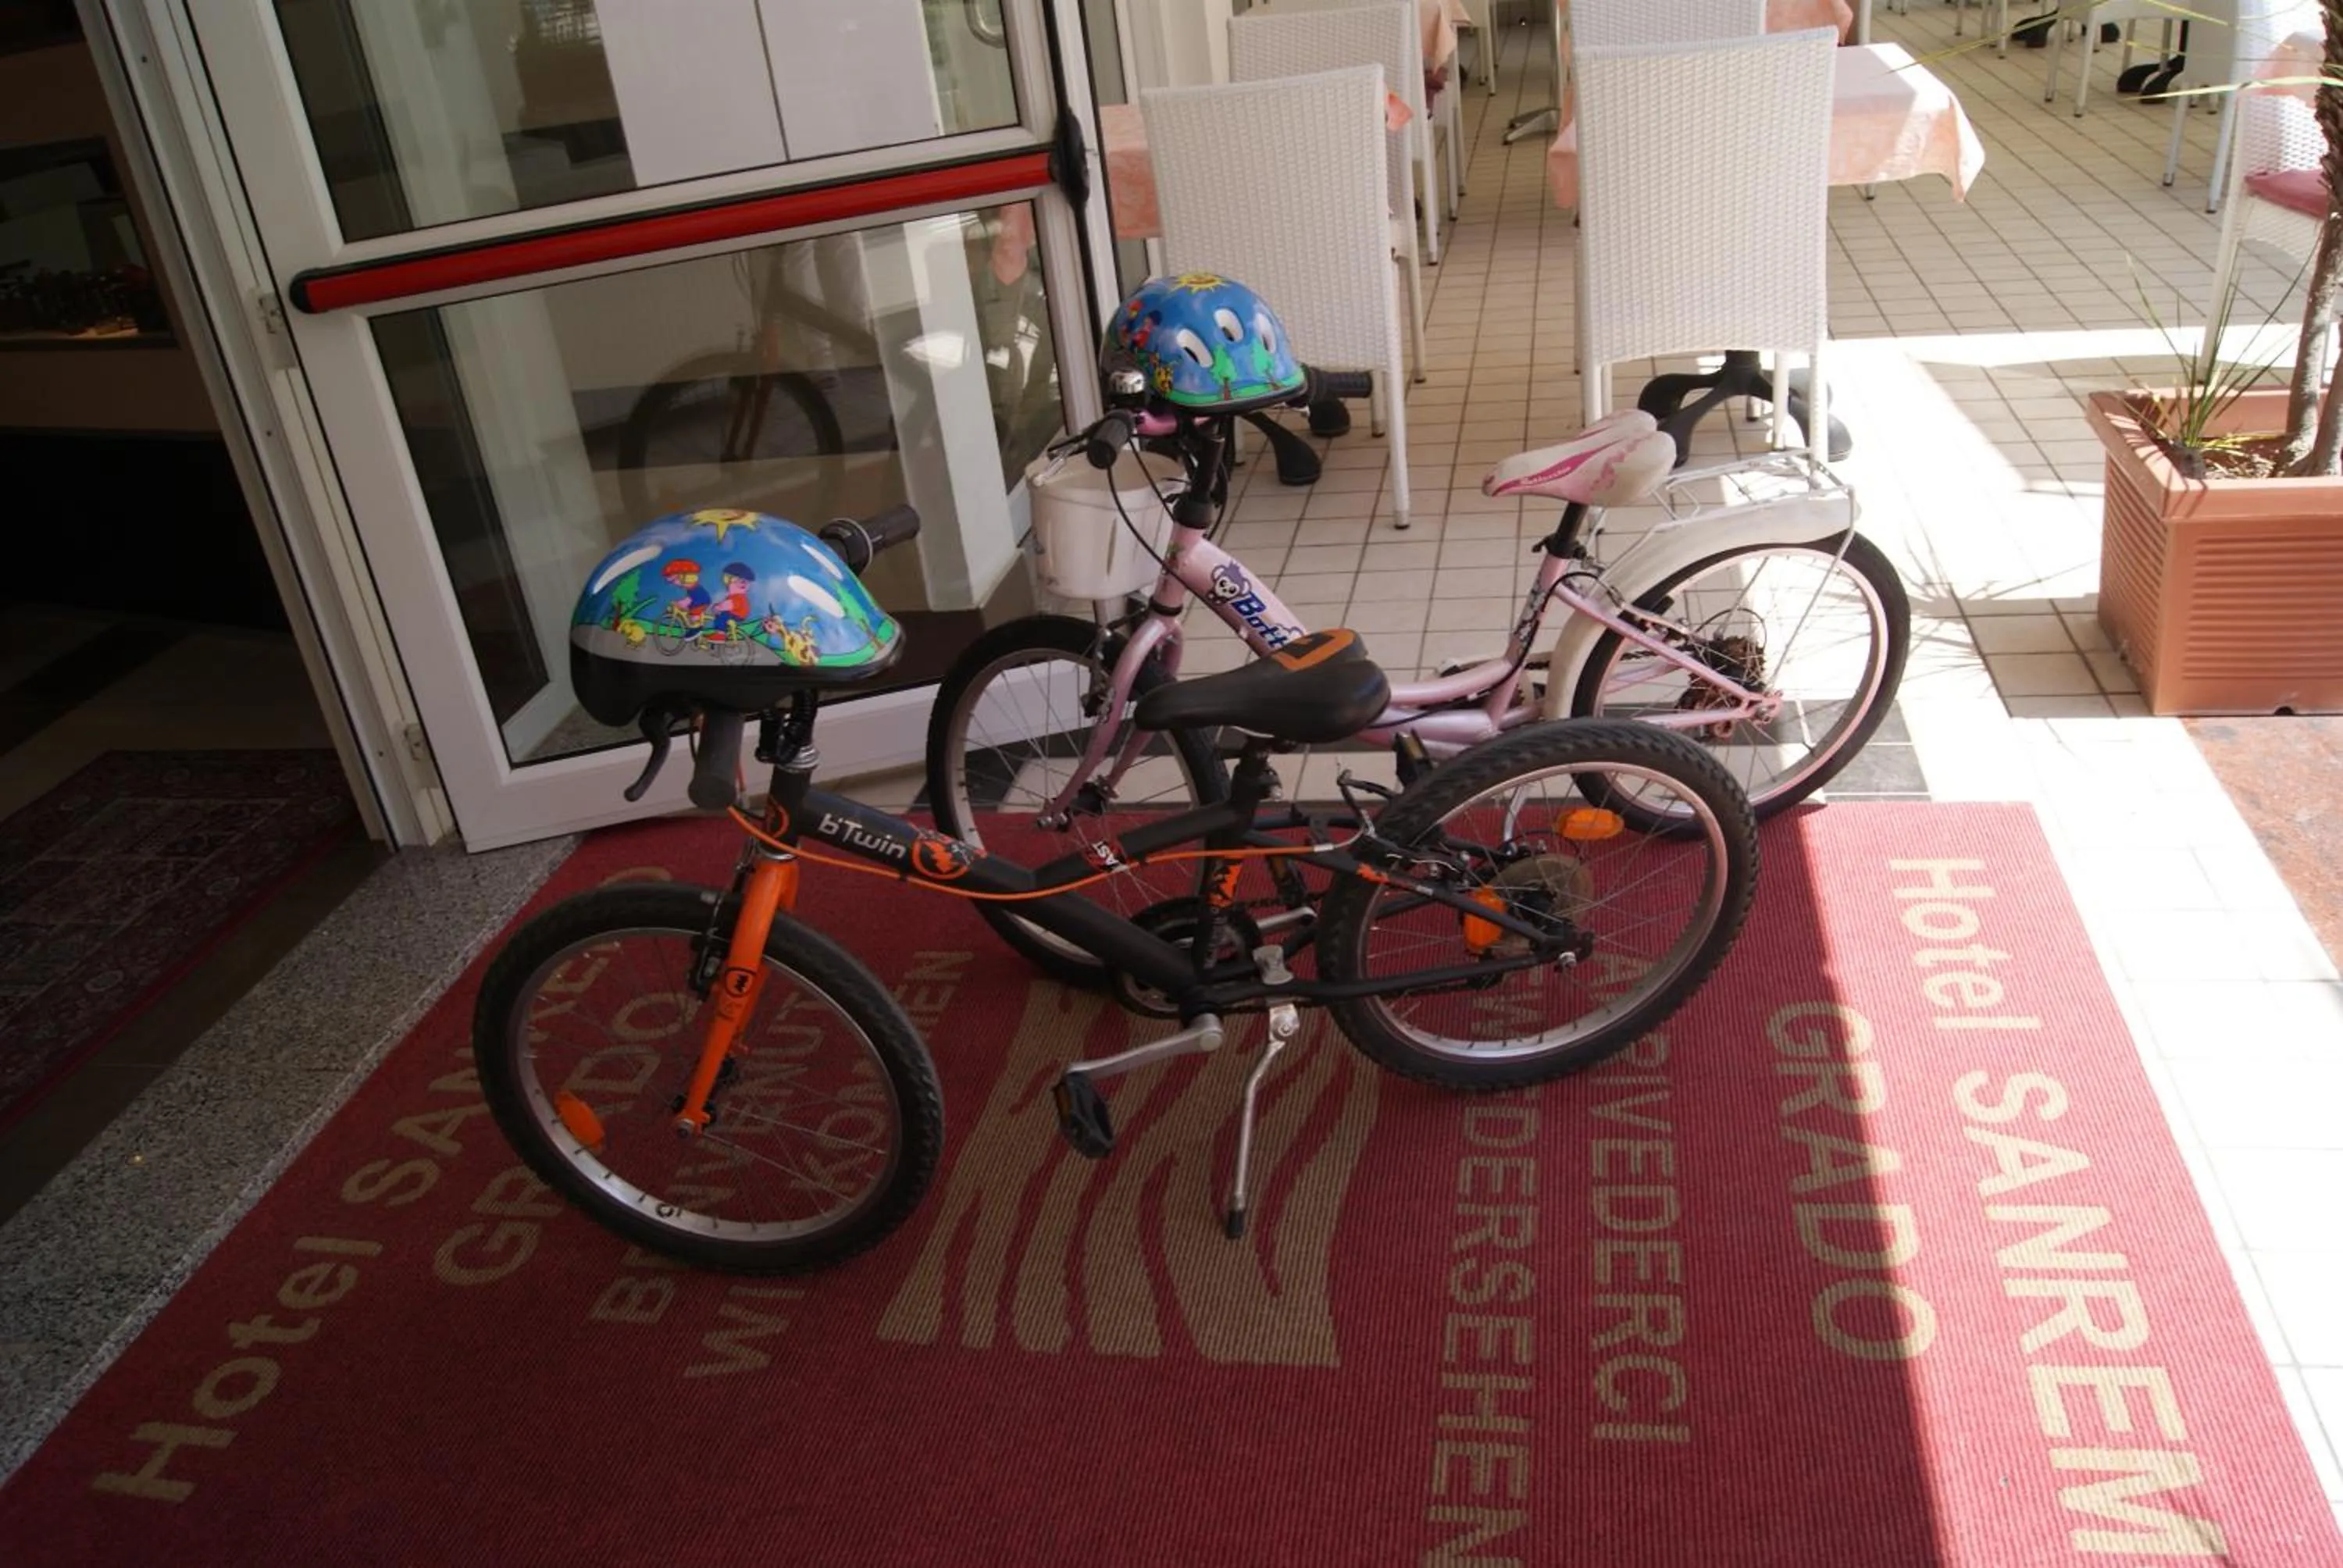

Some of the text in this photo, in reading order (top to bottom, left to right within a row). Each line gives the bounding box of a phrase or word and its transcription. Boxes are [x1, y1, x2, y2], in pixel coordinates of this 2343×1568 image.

[434, 992, 697, 1286] GRDO
[1590, 950, 1692, 1444] ARIVEDERCI
[1766, 1000, 1937, 1361] GRADO
[1889, 857, 2228, 1568] Hotel SANREM
[92, 1235, 383, 1502] Hotel
